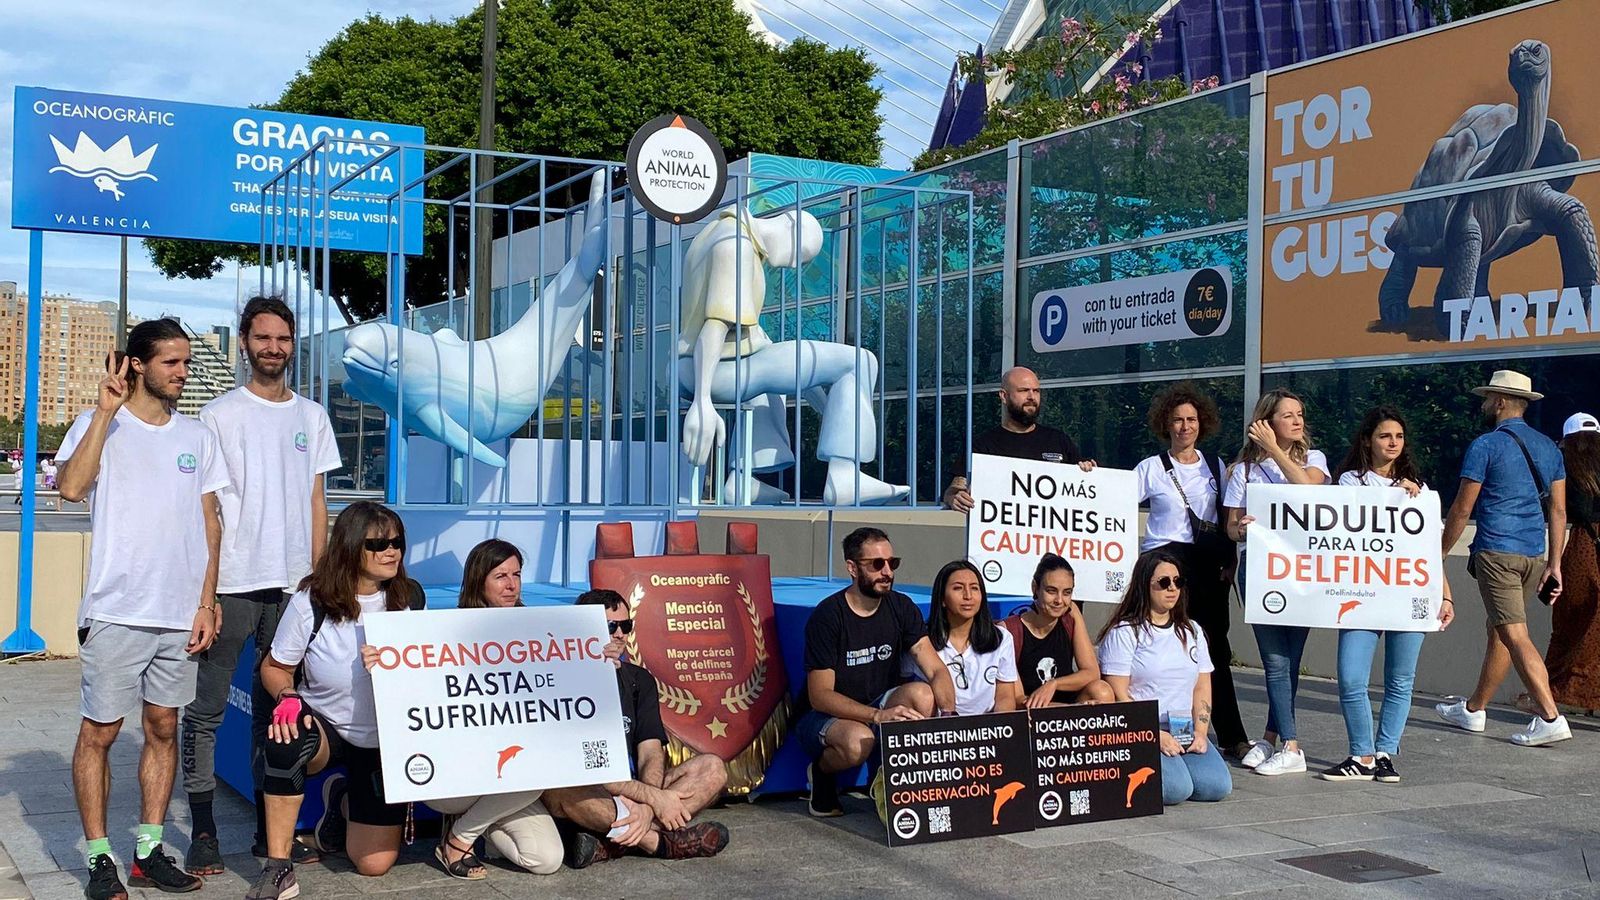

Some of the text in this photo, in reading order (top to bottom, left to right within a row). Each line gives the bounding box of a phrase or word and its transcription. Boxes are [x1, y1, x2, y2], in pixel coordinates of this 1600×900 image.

[33, 100, 175, 126] OCEANOGRÀFIC
[1273, 85, 1373, 156] TOR
[232, 118, 391, 158] GRACIAS
[662, 149, 694, 160] WORLD
[236, 153, 284, 173] POR
[328, 161, 394, 183] VISITA
[644, 159, 711, 179] ANIMAL
[649, 178, 705, 191] PROTECTION
[1272, 155, 1334, 213] TU
[54, 213, 151, 229] VALENCIA
[329, 210, 360, 222] SEUA
[362, 213, 398, 225] VISITA
[1271, 211, 1397, 282] GUES
[1084, 286, 1175, 313] con tu entrada
[1197, 285, 1215, 303] 7€
[1082, 309, 1177, 336] with your ticket
[1011, 470, 1097, 500] NO MÁS
[980, 499, 1126, 534] DELFINES EN
[1269, 502, 1425, 535] INDULTO
[980, 529, 1124, 563] CAUTIVERIO
[1308, 536, 1394, 553] PARA LOS
[650, 573, 731, 588] Oceanogràfic
[1267, 552, 1430, 587] DELFINES
[665, 600, 724, 615] Mención
[667, 617, 726, 634] Especial
[377, 632, 602, 671] OCEANOGRÀFIC
[667, 647, 735, 660] Mayor cárcel
[674, 659, 733, 670] de delfines
[445, 670, 556, 698] BASTA DE
[678, 671, 734, 684] en España
[407, 696, 596, 732] SUFRIMIENTO
[888, 725, 1013, 748] EL ENTRETENIMIENTO
[1036, 730, 1156, 751] BASTA DE SUFRIMIENTO,
[888, 746, 996, 768] CON DELFINES EN
[1037, 748, 1131, 768] NO MÁS DELFINES
[889, 763, 1003, 786] CAUTIVERIO NO ES
[1038, 773, 1053, 787] EN
[891, 782, 990, 805] CONSERVACIÓN
